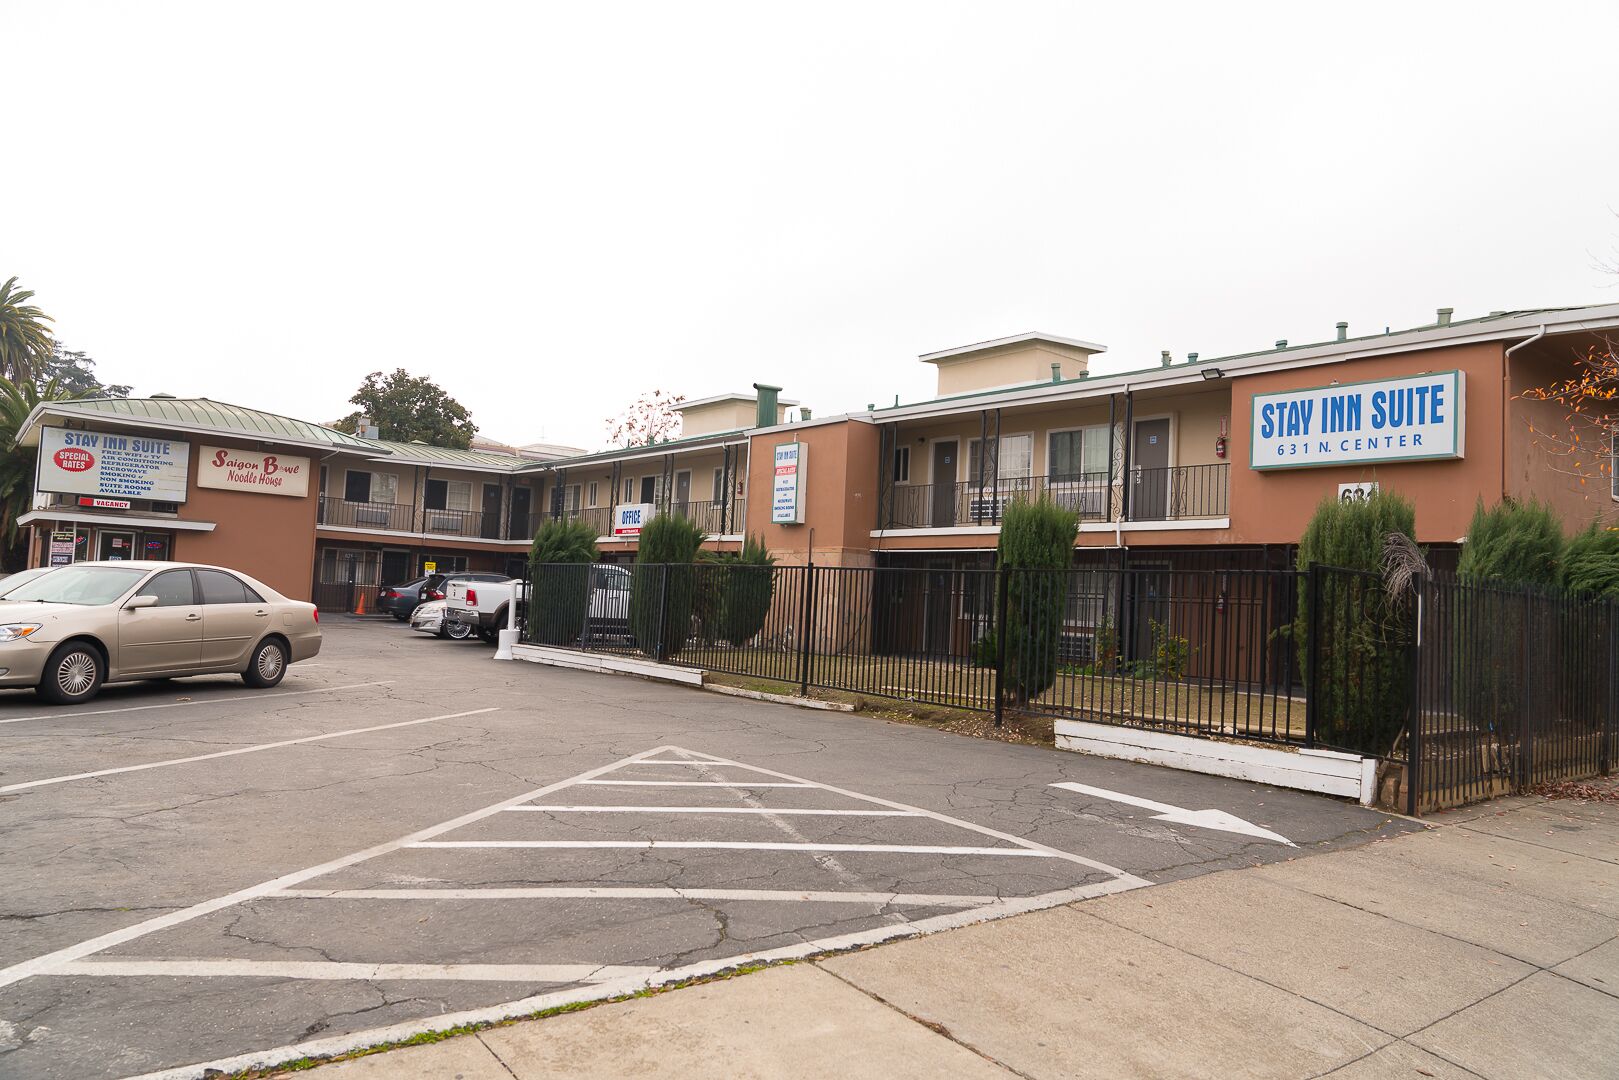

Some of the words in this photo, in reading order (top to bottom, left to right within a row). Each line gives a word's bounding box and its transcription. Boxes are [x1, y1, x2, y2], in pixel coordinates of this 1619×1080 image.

[1261, 398, 1314, 438] STAY
[1322, 394, 1362, 434] INN
[1372, 384, 1444, 429] SUITE
[65, 432, 99, 448] STAY
[103, 436, 127, 450] INN
[132, 439, 170, 455] SUITE
[1278, 442, 1308, 456] 631
[1319, 442, 1332, 453] N.
[1340, 434, 1422, 452] CENTER
[60, 451, 90, 461] SPECIAL
[117, 457, 173, 466] CONDITIONING
[212, 450, 258, 470] Saigon
[62, 460, 85, 469] RATES
[101, 460, 160, 470] REFRIGERATOR
[101, 466, 148, 474] MICROWAVE
[227, 470, 257, 484] Noodle
[259, 473, 282, 487] House
[96, 500, 128, 508] VACANCY
[622, 510, 640, 524] OFFICE
